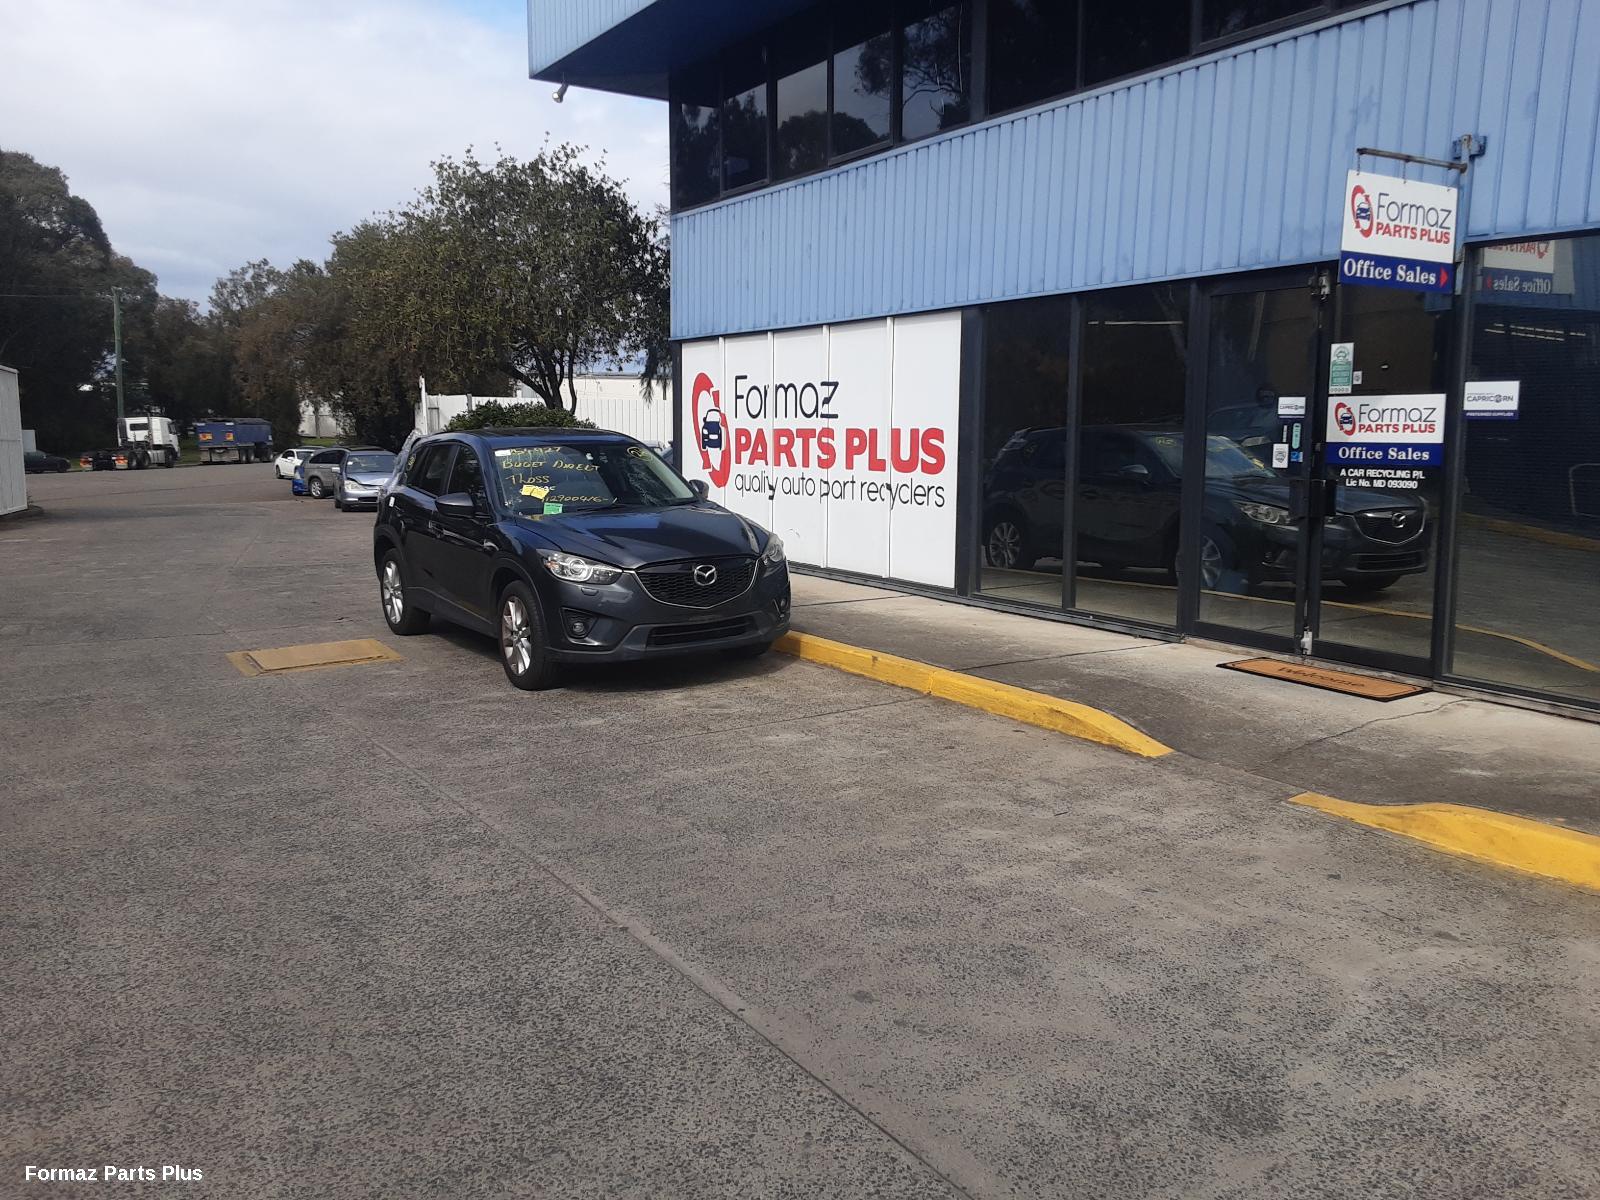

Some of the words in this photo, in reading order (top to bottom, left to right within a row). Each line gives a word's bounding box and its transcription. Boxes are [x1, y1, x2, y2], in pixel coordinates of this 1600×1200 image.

[1377, 192, 1452, 230] Formaz
[1375, 222, 1418, 240] PARTS
[1420, 230, 1451, 244] PLUS
[1343, 258, 1391, 281] Office
[1396, 264, 1437, 285] Sales
[735, 374, 840, 419] Formaz
[1358, 403, 1437, 423] Formaz
[1358, 423, 1400, 434] PARTS
[1402, 423, 1435, 434] PLUS
[735, 427, 837, 470] PARTS
[845, 427, 946, 475] PLUS
[1339, 447, 1383, 460] Office
[1388, 447, 1430, 461] Sales
[1340, 468, 1347, 477] A
[1348, 468, 1365, 477] CAR
[1366, 469, 1411, 478] RECYCLING
[1345, 478, 1358, 486] Lic
[1373, 479, 1386, 488] MD
[1387, 480, 1418, 489] 093090
[735, 470, 779, 500] qualiy
[782, 472, 816, 496] auto
[820, 475, 857, 504] part
[860, 478, 946, 510] recyclers
